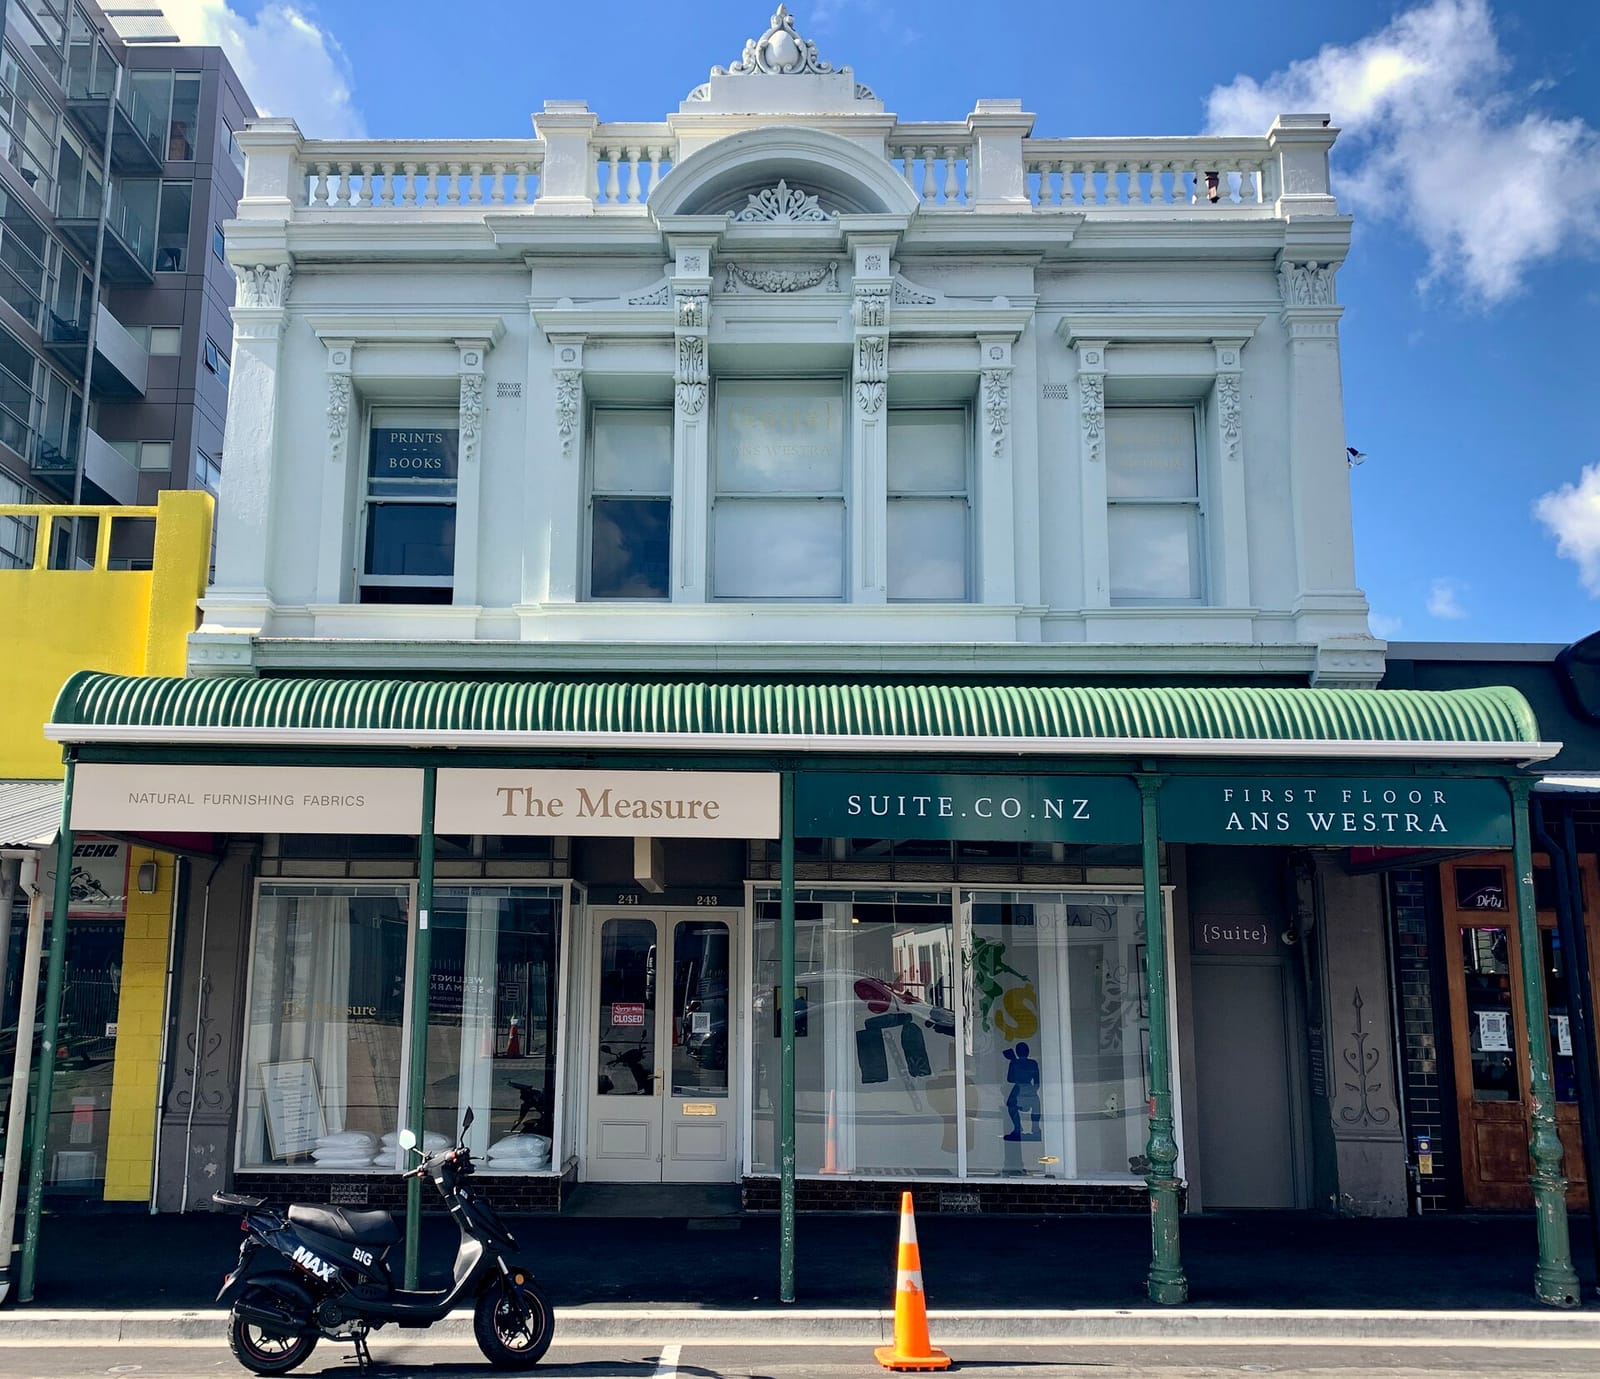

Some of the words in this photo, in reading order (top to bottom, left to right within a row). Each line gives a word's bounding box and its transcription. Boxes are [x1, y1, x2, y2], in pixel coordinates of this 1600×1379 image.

[390, 432, 443, 444] PRINTS
[389, 457, 442, 469] BOOKS
[128, 792, 194, 804] NATURAL
[203, 793, 294, 805] FURNISHING
[303, 794, 365, 806] FABRICS
[496, 787, 564, 817] The
[575, 787, 720, 820] Measure
[1223, 789, 1317, 804] FIRST
[1341, 789, 1448, 804] FLOOR
[847, 795, 1091, 821] SUITE.CO.NZ
[1225, 813, 1291, 832] ANS
[1306, 813, 1449, 833] WESTRA
[618, 894, 639, 904] 241
[697, 896, 718, 906] 243
[1476, 894, 1502, 908] Dirty
[613, 1015, 643, 1023] CLOSED
[352, 1247, 374, 1266] BIG
[292, 1245, 336, 1283] MAX
